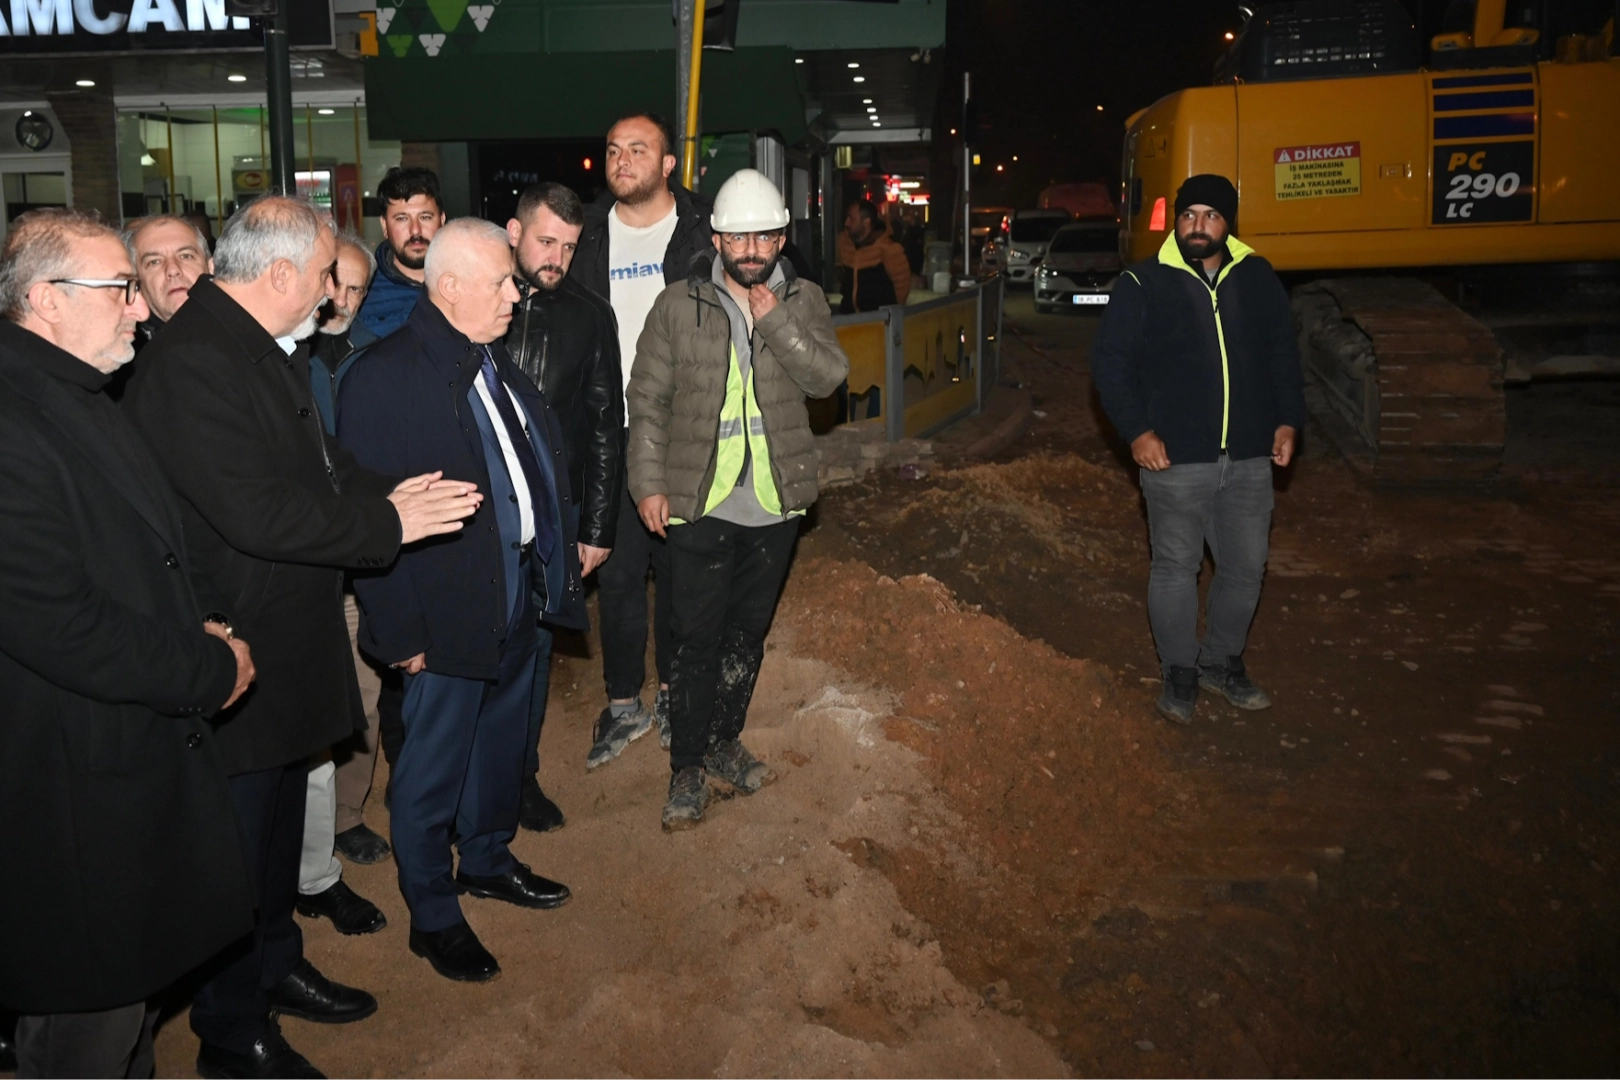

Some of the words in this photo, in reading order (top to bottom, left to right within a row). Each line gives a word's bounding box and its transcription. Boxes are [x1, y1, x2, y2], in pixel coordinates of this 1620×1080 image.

[1294, 146, 1354, 161] DİKKAT
[1298, 161, 1345, 171] MAKİNASINA
[1447, 151, 1487, 172] PC
[1303, 170, 1342, 179] METREDEN
[1308, 178, 1352, 188] YAKLAŞMAK
[1445, 172, 1520, 200] 290
[1277, 189, 1313, 199] TEHLİKELİ
[1314, 188, 1323, 196] VE
[1325, 186, 1359, 195] YASAKTIR
[1446, 202, 1474, 218] LC
